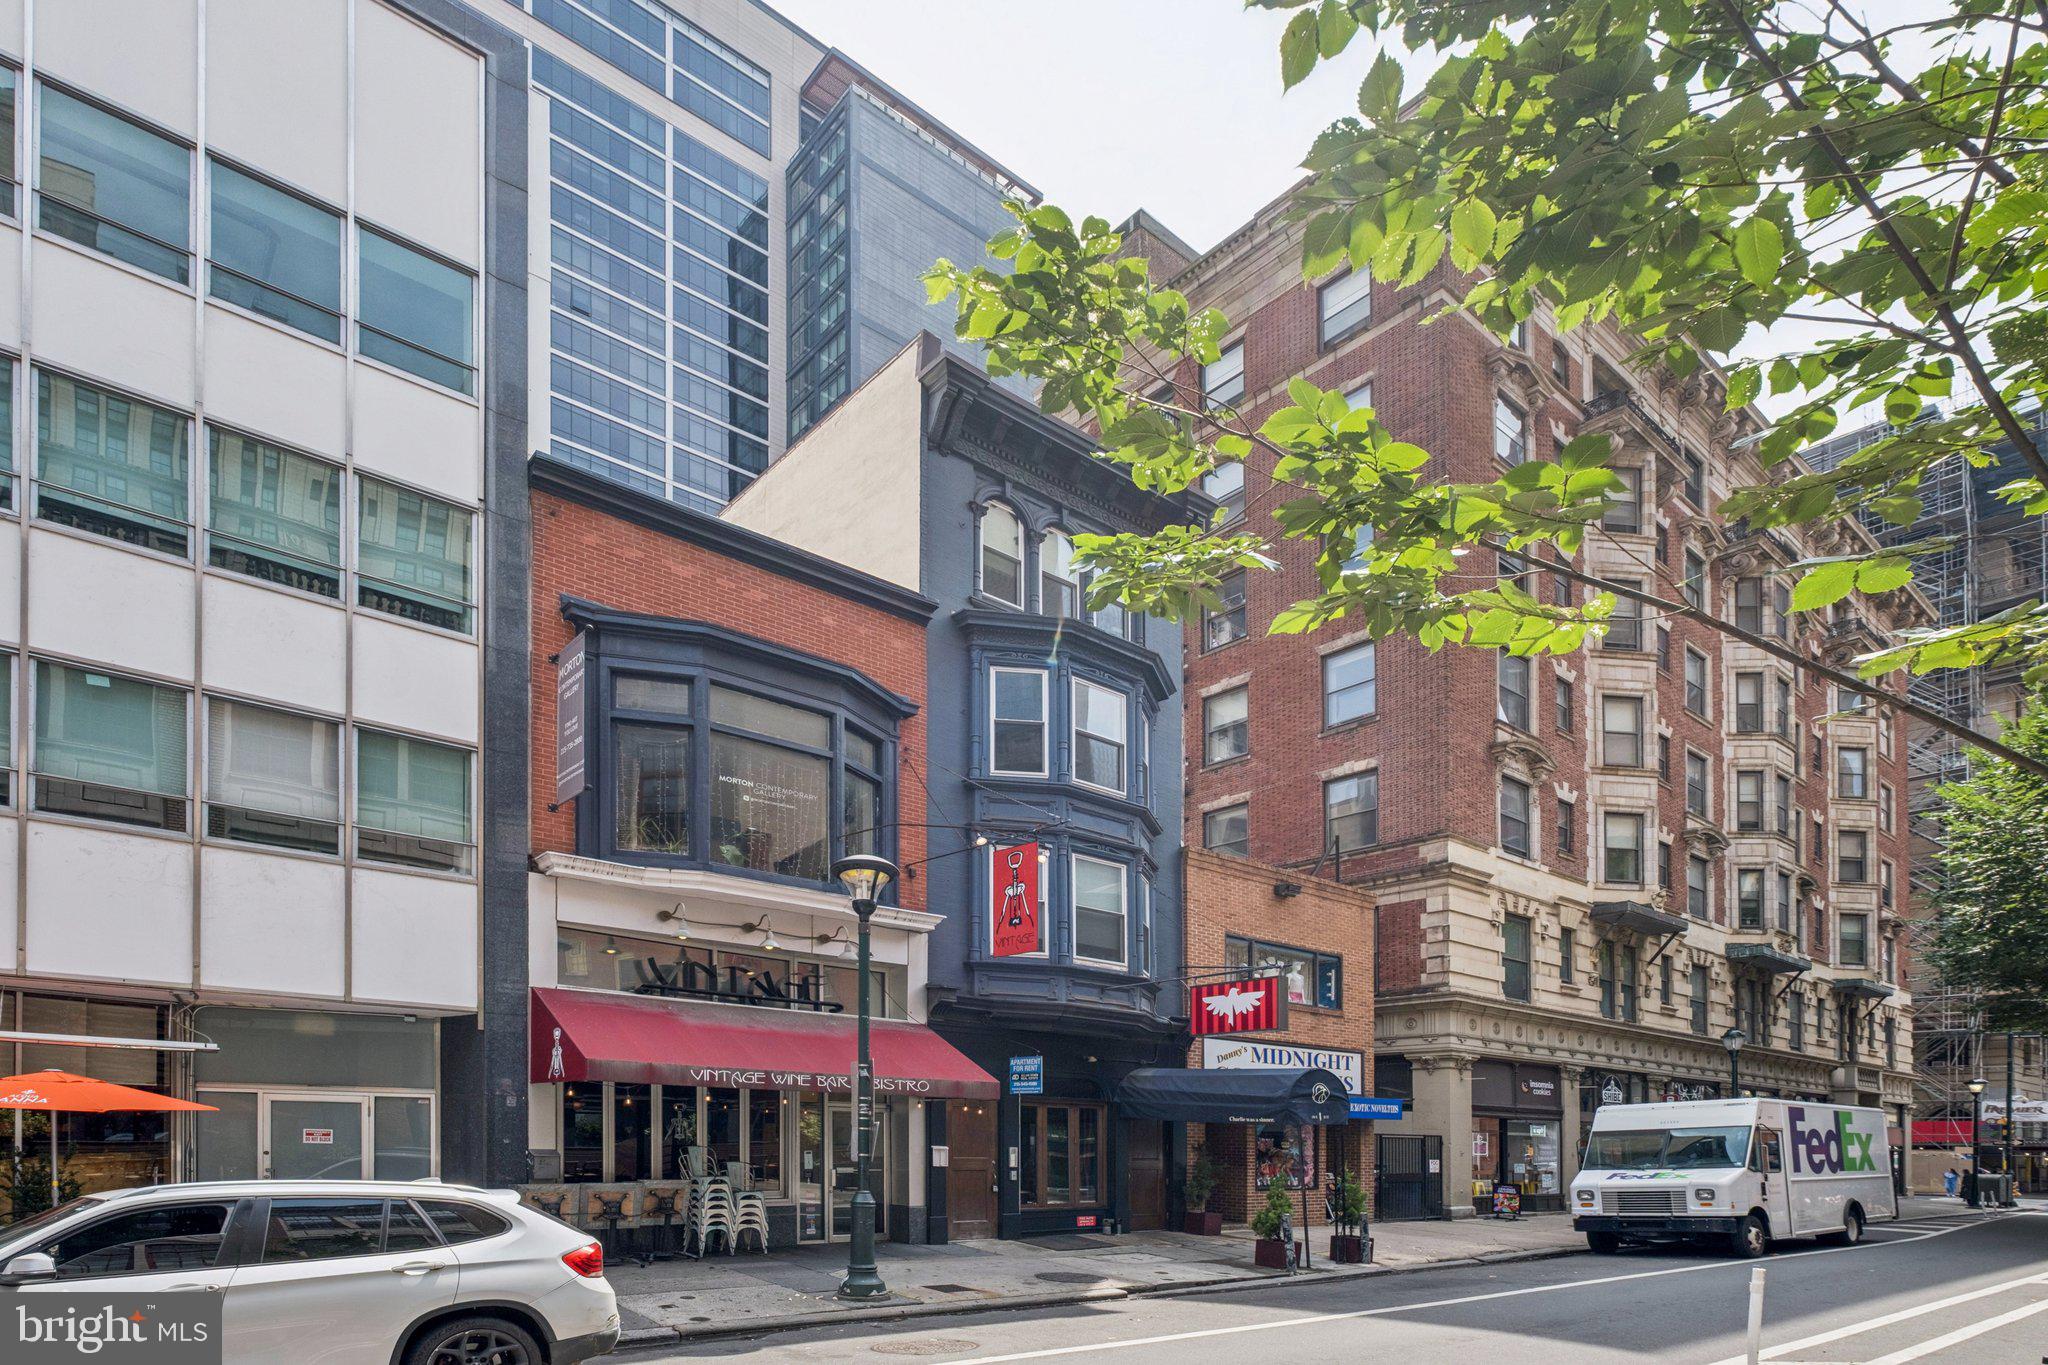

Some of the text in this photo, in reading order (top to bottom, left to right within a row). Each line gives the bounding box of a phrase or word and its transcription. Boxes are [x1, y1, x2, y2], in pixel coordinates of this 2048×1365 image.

[719, 775, 818, 801] MORTON CONTEMPORARY
[753, 788, 786, 799] GALLERY
[1216, 1045, 1354, 1071] Danny's MIDNIGHT
[690, 1069, 930, 1092] VINTAGE WINE BAR BISTRO
[1530, 1080, 1554, 1089] insomnia
[1603, 1092, 1621, 1101] SHIBE
[1350, 1103, 1370, 1112] EXOTIC
[1787, 1106, 1876, 1175] FedEx
[1606, 1172, 1691, 1180] FedEx
